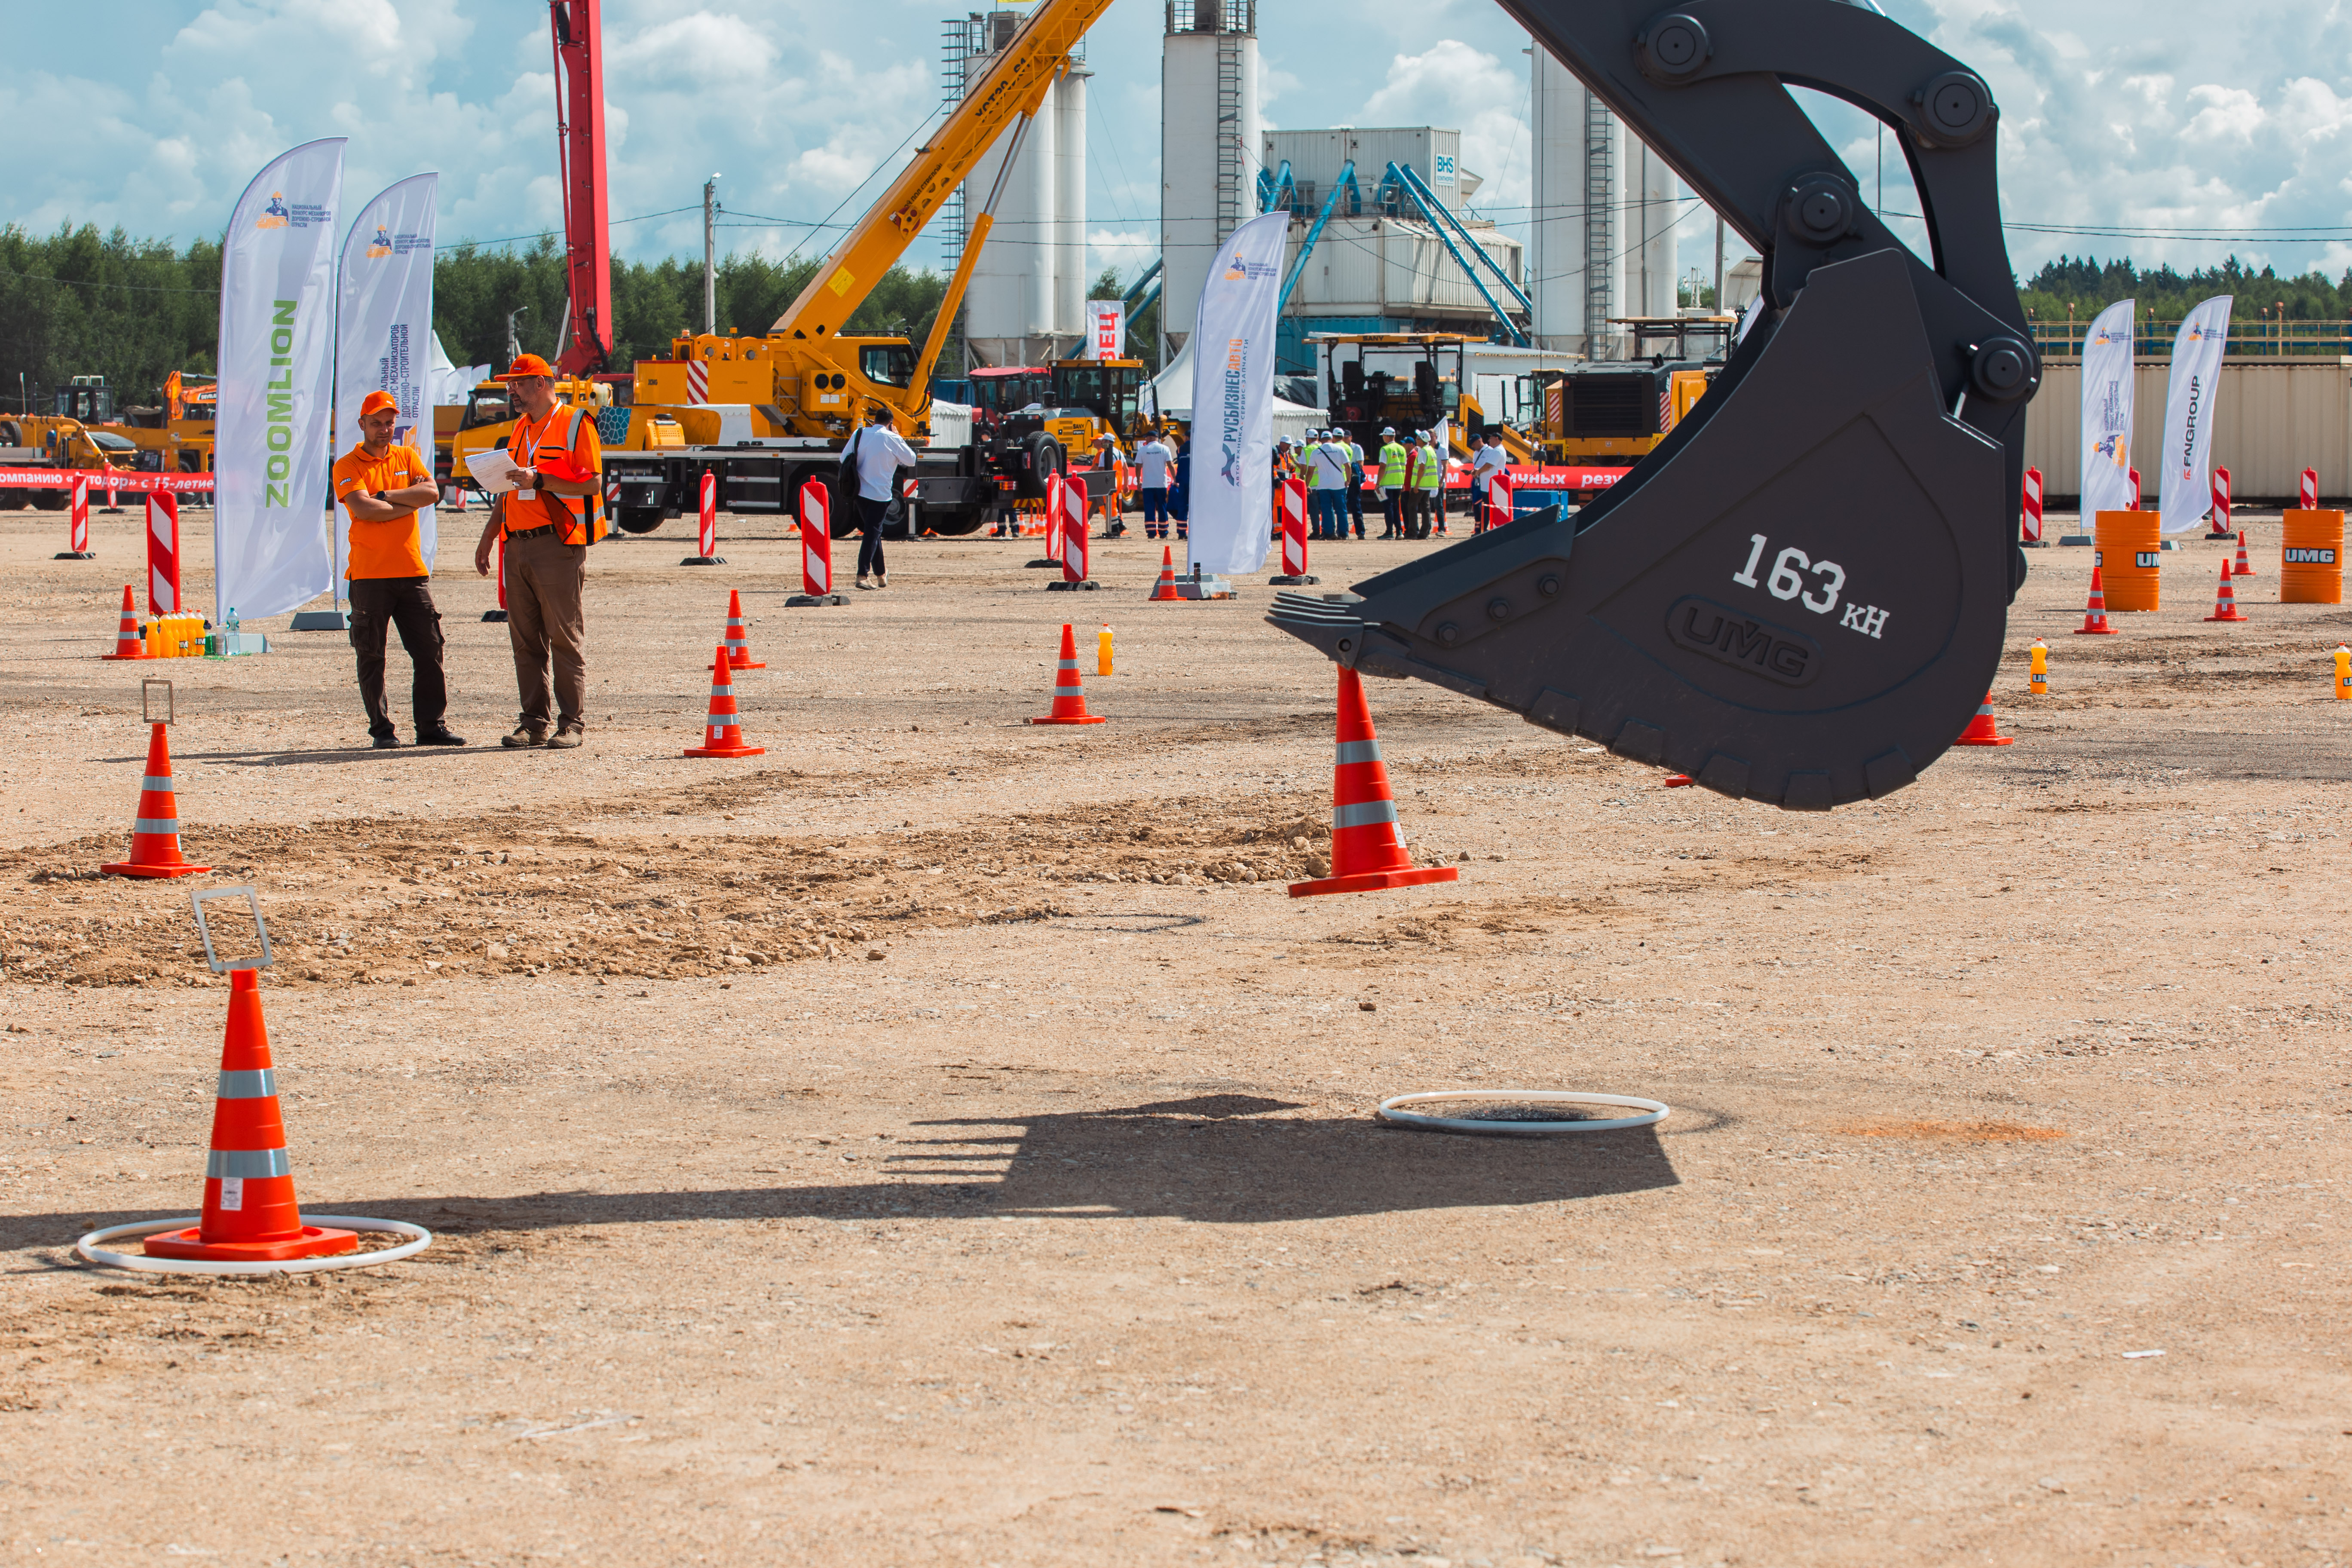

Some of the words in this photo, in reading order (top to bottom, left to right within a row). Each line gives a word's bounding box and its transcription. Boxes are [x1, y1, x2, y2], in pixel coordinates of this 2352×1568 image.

[1437, 156, 1453, 173] BHS
[390, 325, 399, 384] МЕХАНИЗАТОРОВ
[400, 324, 411, 418] ДОРОЖНО-СТРОИТЕЛЬНОЙ
[1223, 338, 1243, 442] РУСБИЗНЕСАВТО
[266, 300, 297, 508] ZOOMLION
[2184, 375, 2200, 467] FNGROUP
[141, 480, 148, 488] с
[1733, 533, 1846, 614] 163
[2285, 548, 2334, 563] UMG
[1681, 606, 1809, 678] UMG
